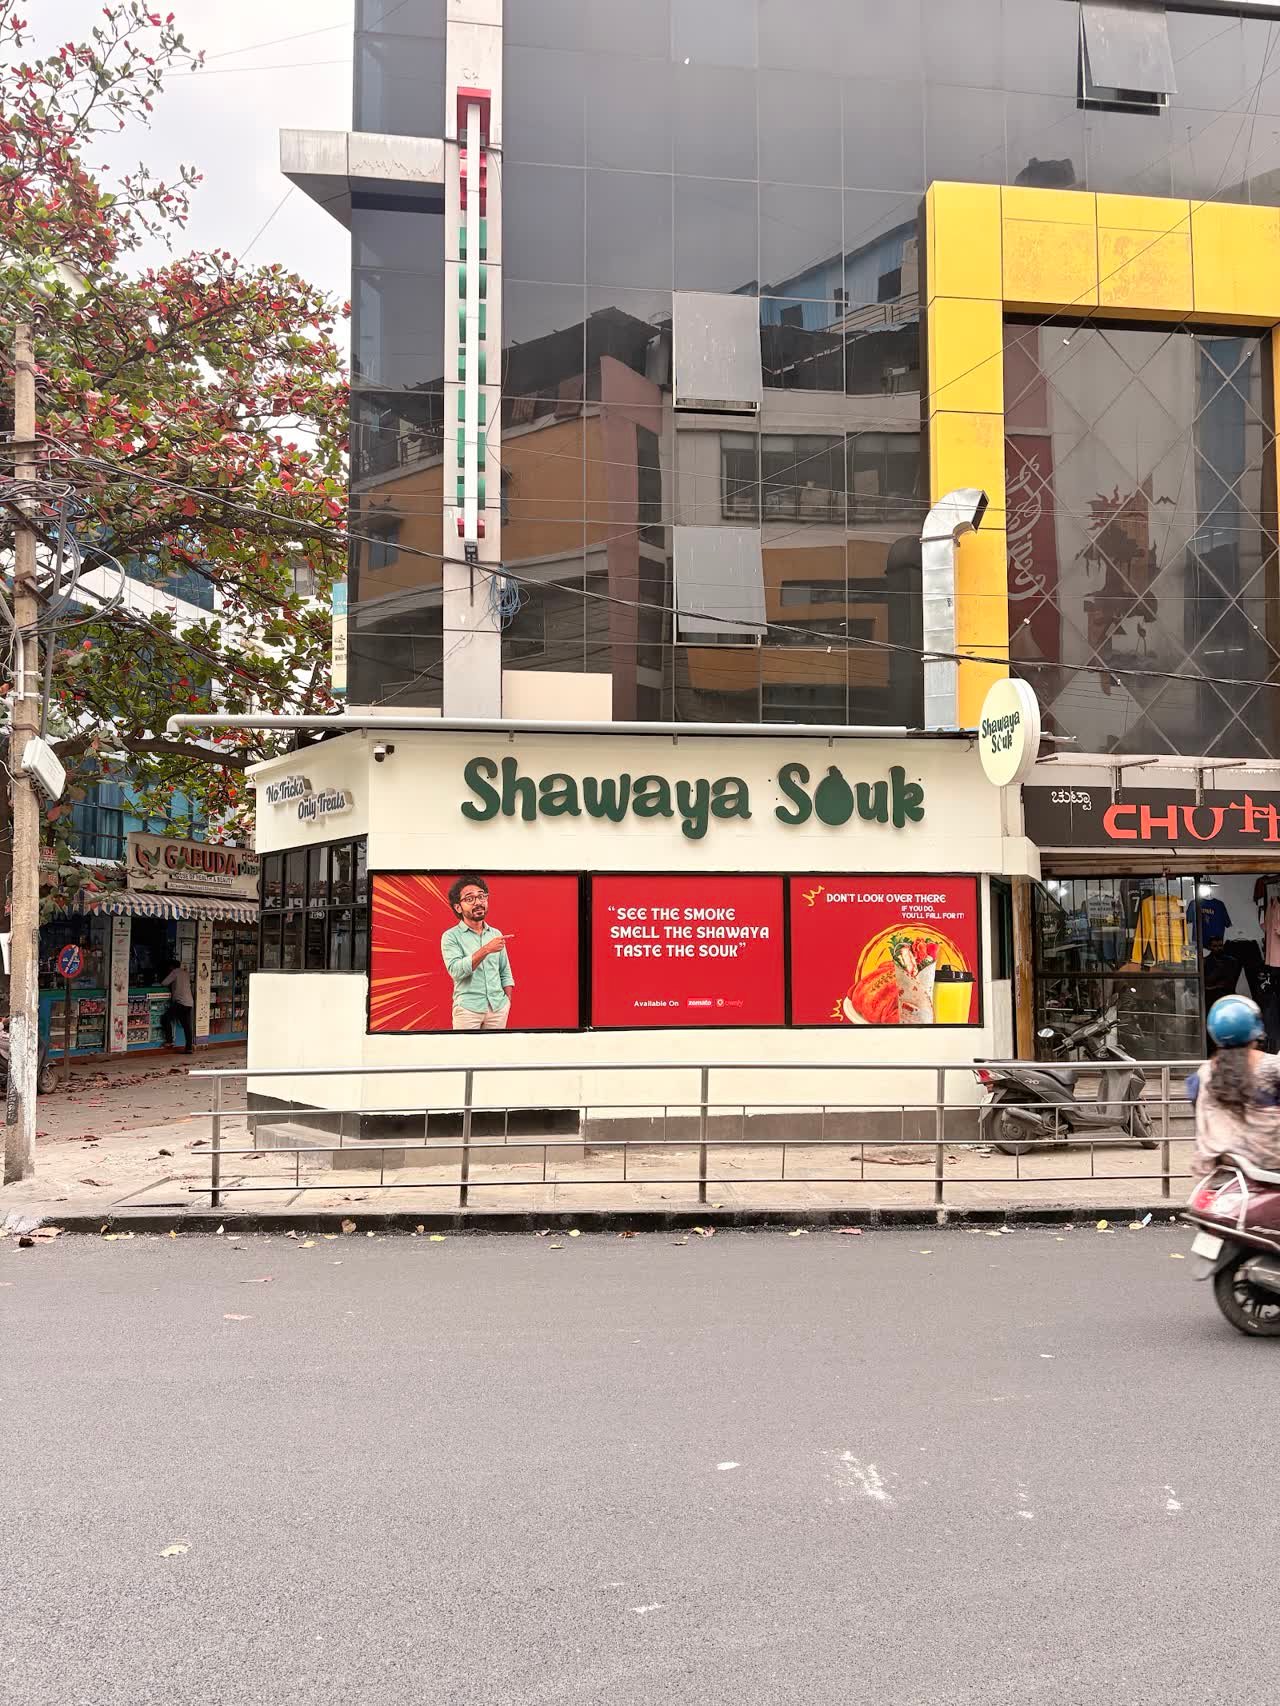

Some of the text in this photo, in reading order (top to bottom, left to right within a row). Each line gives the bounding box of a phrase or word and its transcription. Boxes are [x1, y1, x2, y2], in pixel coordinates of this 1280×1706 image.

[982, 711, 1020, 738] Shawaya
[266, 779, 304, 803] No Tricks
[461, 756, 925, 839] Shawaya Souk
[298, 792, 346, 819] Only Treats
[826, 893, 946, 903] DON'T LOOK OVER THERE
[651, 908, 680, 921] THE
[683, 908, 736, 921] SMOKE
[610, 926, 770, 939] SMELL THE SHAWAYA
[614, 944, 662, 957] TASTE
[666, 944, 695, 957] THE
